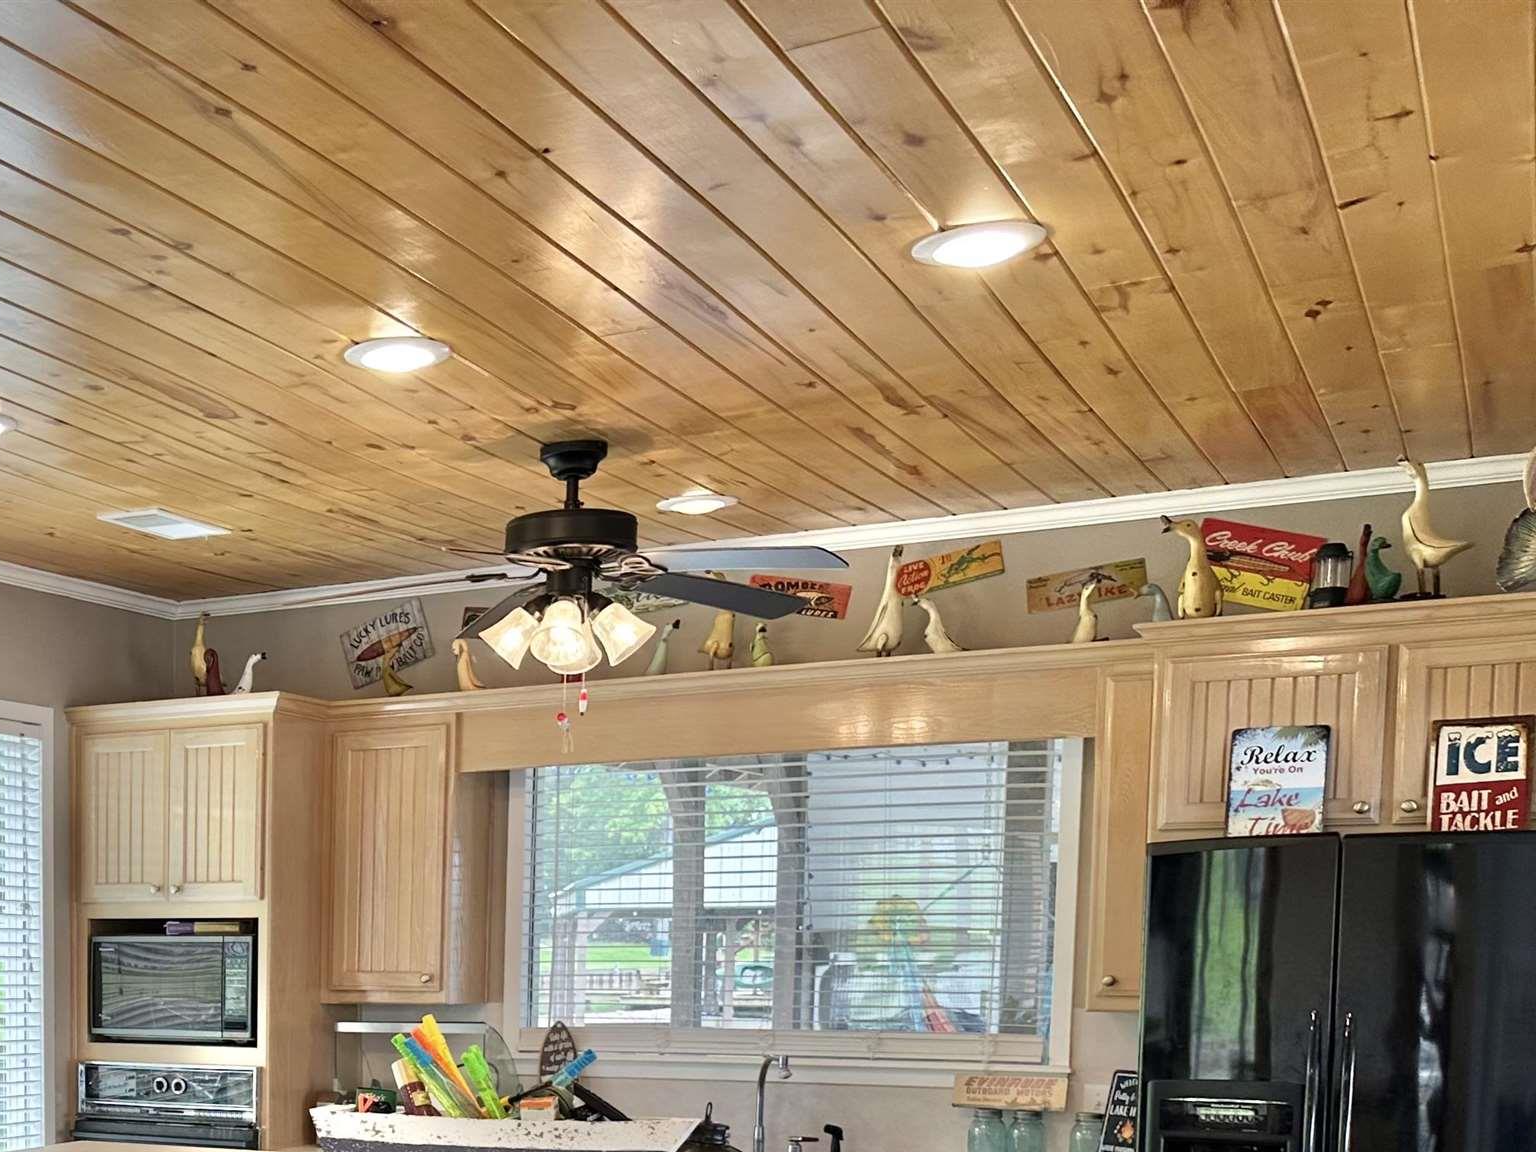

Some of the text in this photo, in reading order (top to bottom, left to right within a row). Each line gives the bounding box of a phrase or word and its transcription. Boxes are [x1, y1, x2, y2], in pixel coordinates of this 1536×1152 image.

[1205, 531, 1319, 563] Creek Chub
[1097, 584, 1127, 598] IKE
[1241, 586, 1261, 599] BAIT
[1262, 591, 1297, 605] CASTER
[349, 612, 411, 649] LUCKY LURES
[1240, 744, 1317, 766] Relax
[1252, 765, 1303, 775] You're On
[1233, 787, 1300, 813] Lake
[1439, 786, 1519, 814] BAIT and
[1439, 809, 1519, 832] TACKLE
